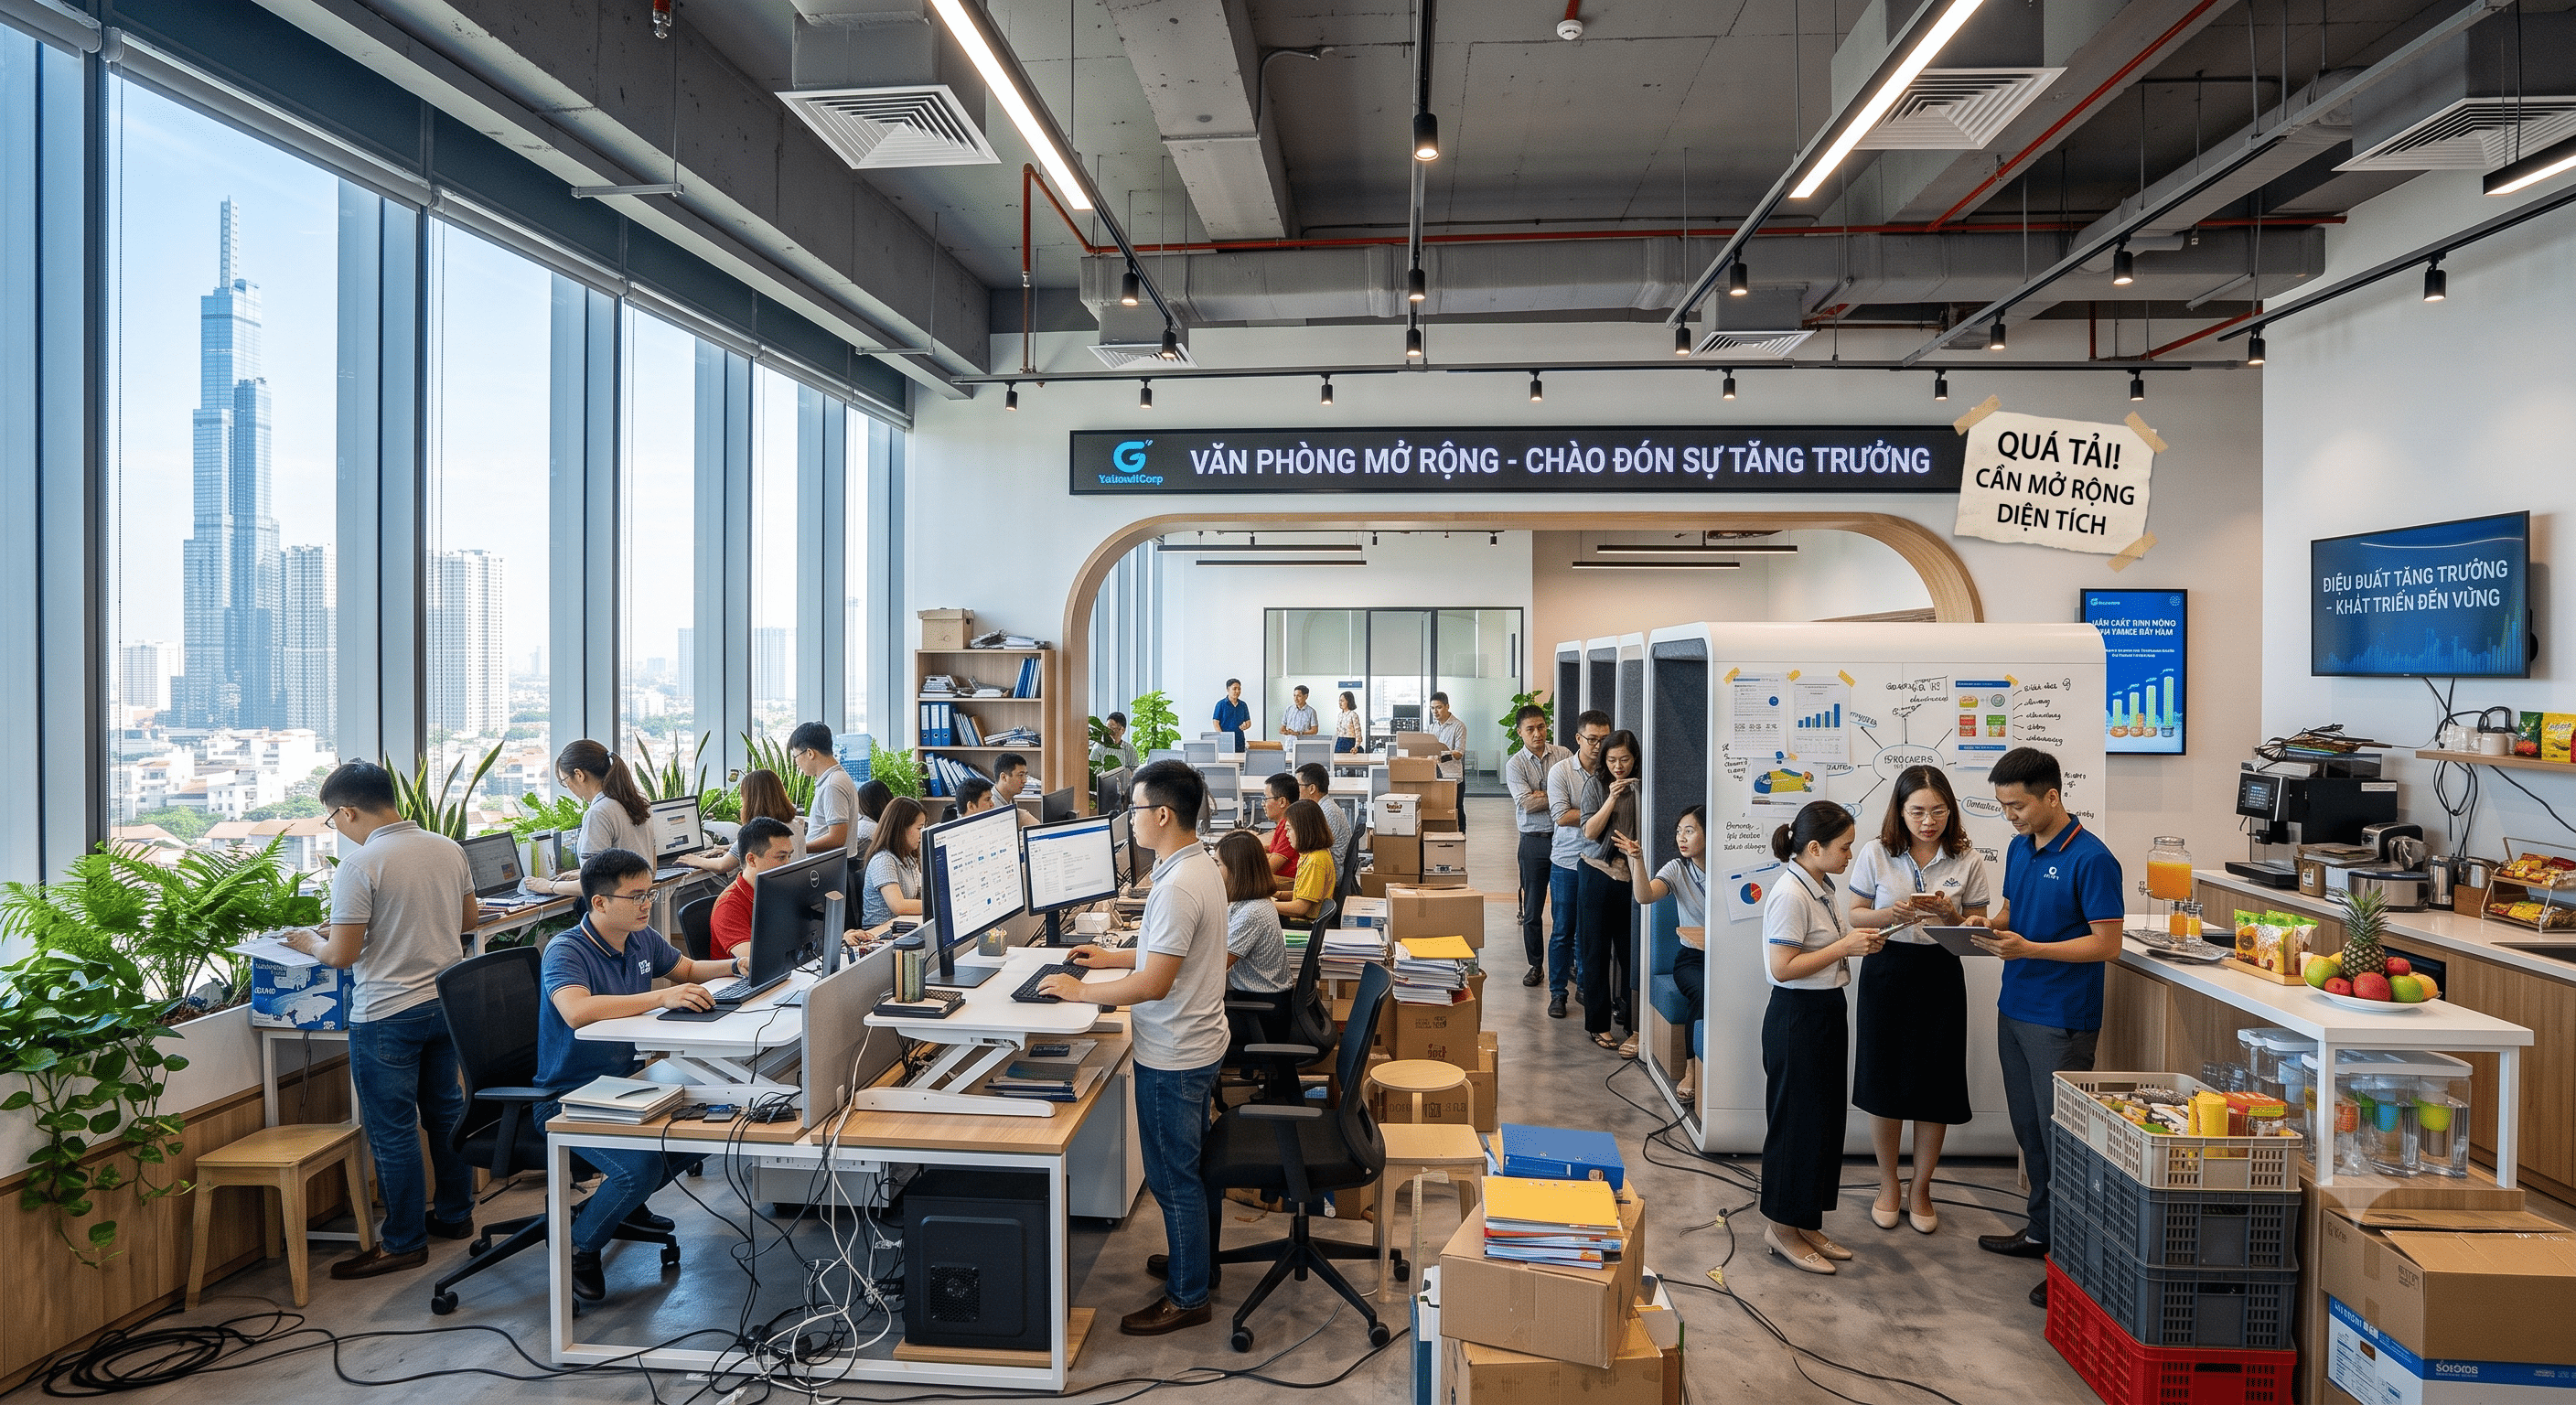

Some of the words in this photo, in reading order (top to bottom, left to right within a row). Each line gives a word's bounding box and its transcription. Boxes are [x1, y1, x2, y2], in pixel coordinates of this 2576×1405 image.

[1189, 441, 1248, 475] VĂN
[1256, 441, 1356, 475] PHÒNG
[1364, 439, 1411, 474] MỞ
[1419, 441, 1499, 480] RỘNG
[1525, 440, 1605, 474] CHÀO
[1612, 439, 1674, 473] ĐÓN
[1682, 445, 1724, 479] SỰ
[1728, 440, 1804, 474] TĂNG
[1811, 439, 1930, 474] TRƯỞNG
[1998, 430, 2060, 463] QUÁ
[2068, 432, 2121, 470] TẢI!
[1976, 464, 2023, 492] CẦN
[2028, 471, 2067, 497] MỞ
[2071, 477, 2136, 507] RỘNG
[1997, 502, 2049, 531] DIỆN
[2055, 508, 2107, 535] TÍCH
[2393, 565, 2434, 587] TĂNG
